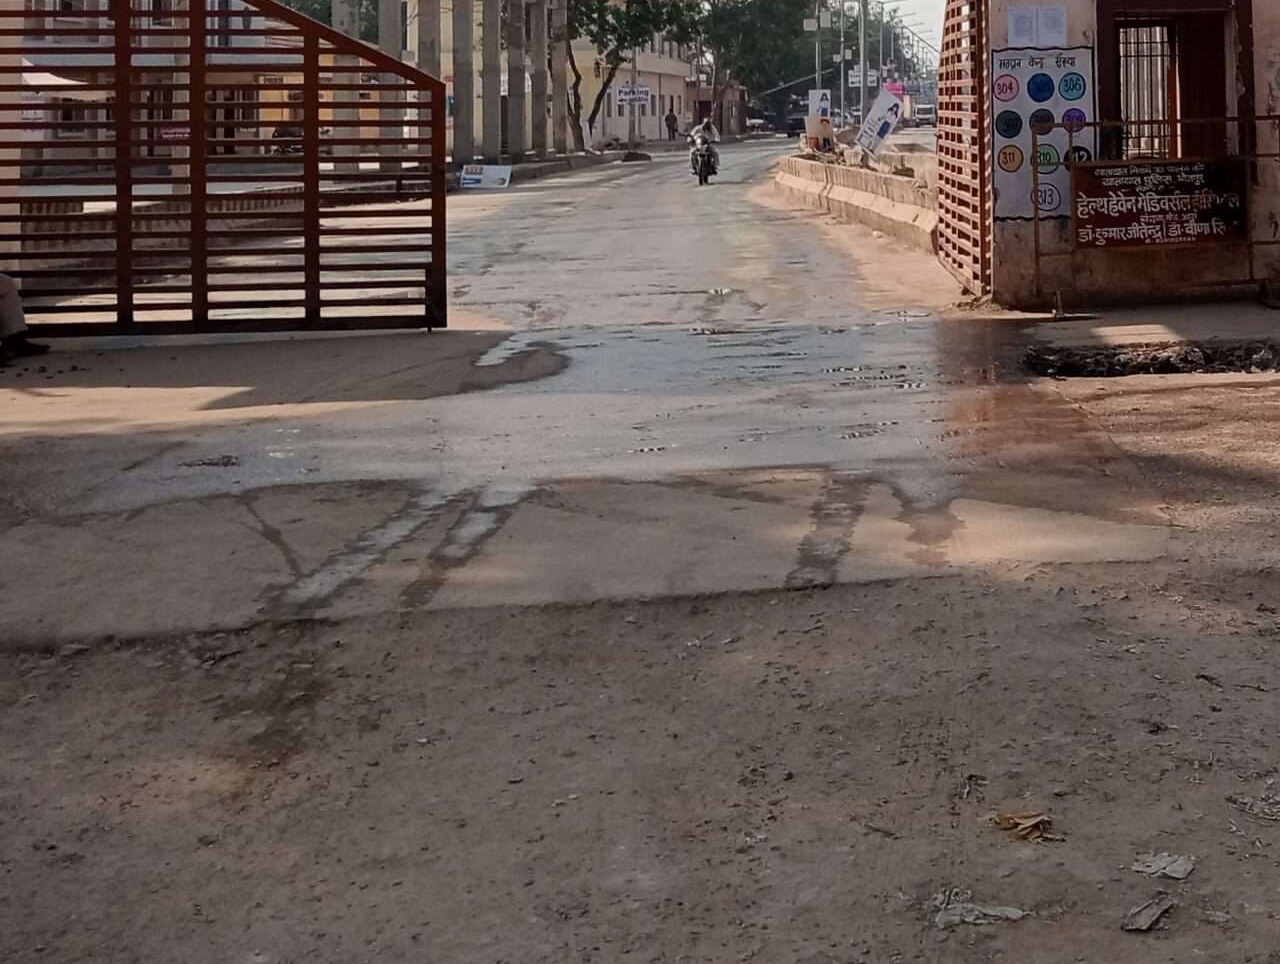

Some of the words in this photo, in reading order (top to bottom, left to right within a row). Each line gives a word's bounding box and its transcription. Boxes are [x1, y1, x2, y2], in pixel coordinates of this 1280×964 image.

[1064, 76, 1081, 93] 306
[1002, 151, 1015, 165] 311
[1074, 151, 1088, 163] 12
[1076, 192, 1108, 218] हेल्थ
